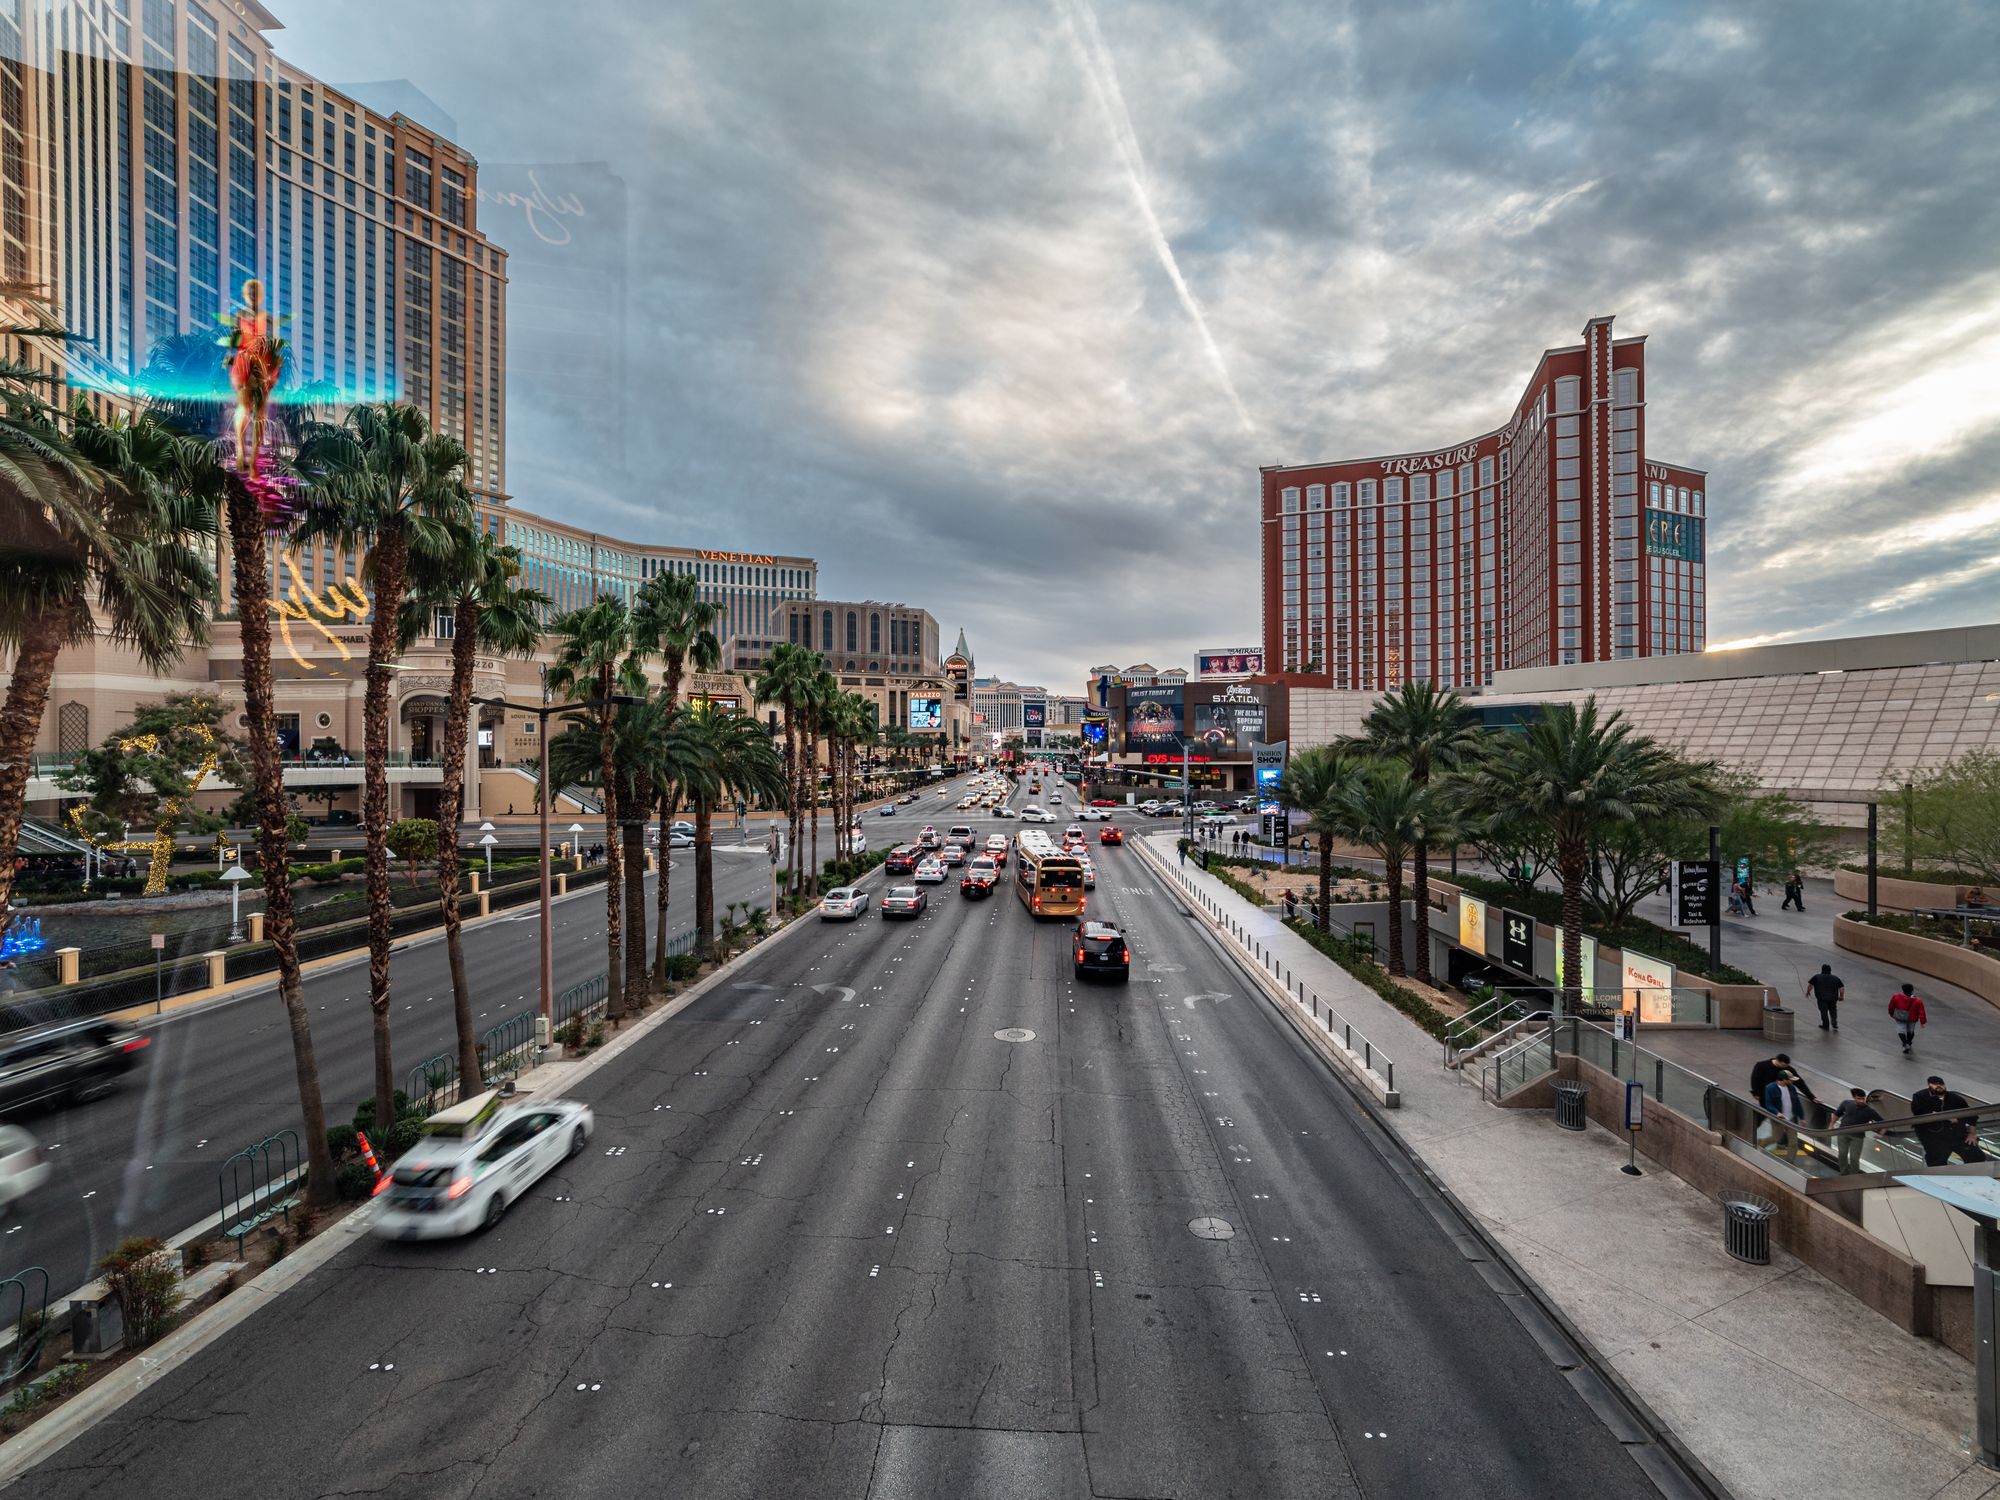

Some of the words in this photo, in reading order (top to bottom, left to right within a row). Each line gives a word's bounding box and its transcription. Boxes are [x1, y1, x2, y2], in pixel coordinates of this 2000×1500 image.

[1381, 443, 1478, 475] TREASURE
[700, 549, 774, 565] VENETIAN
[694, 680, 734, 691] SHOPPES
[1147, 754, 1168, 764] CVS
[1121, 887, 1154, 896] ONLY
[1684, 894, 1700, 902] Bridge
